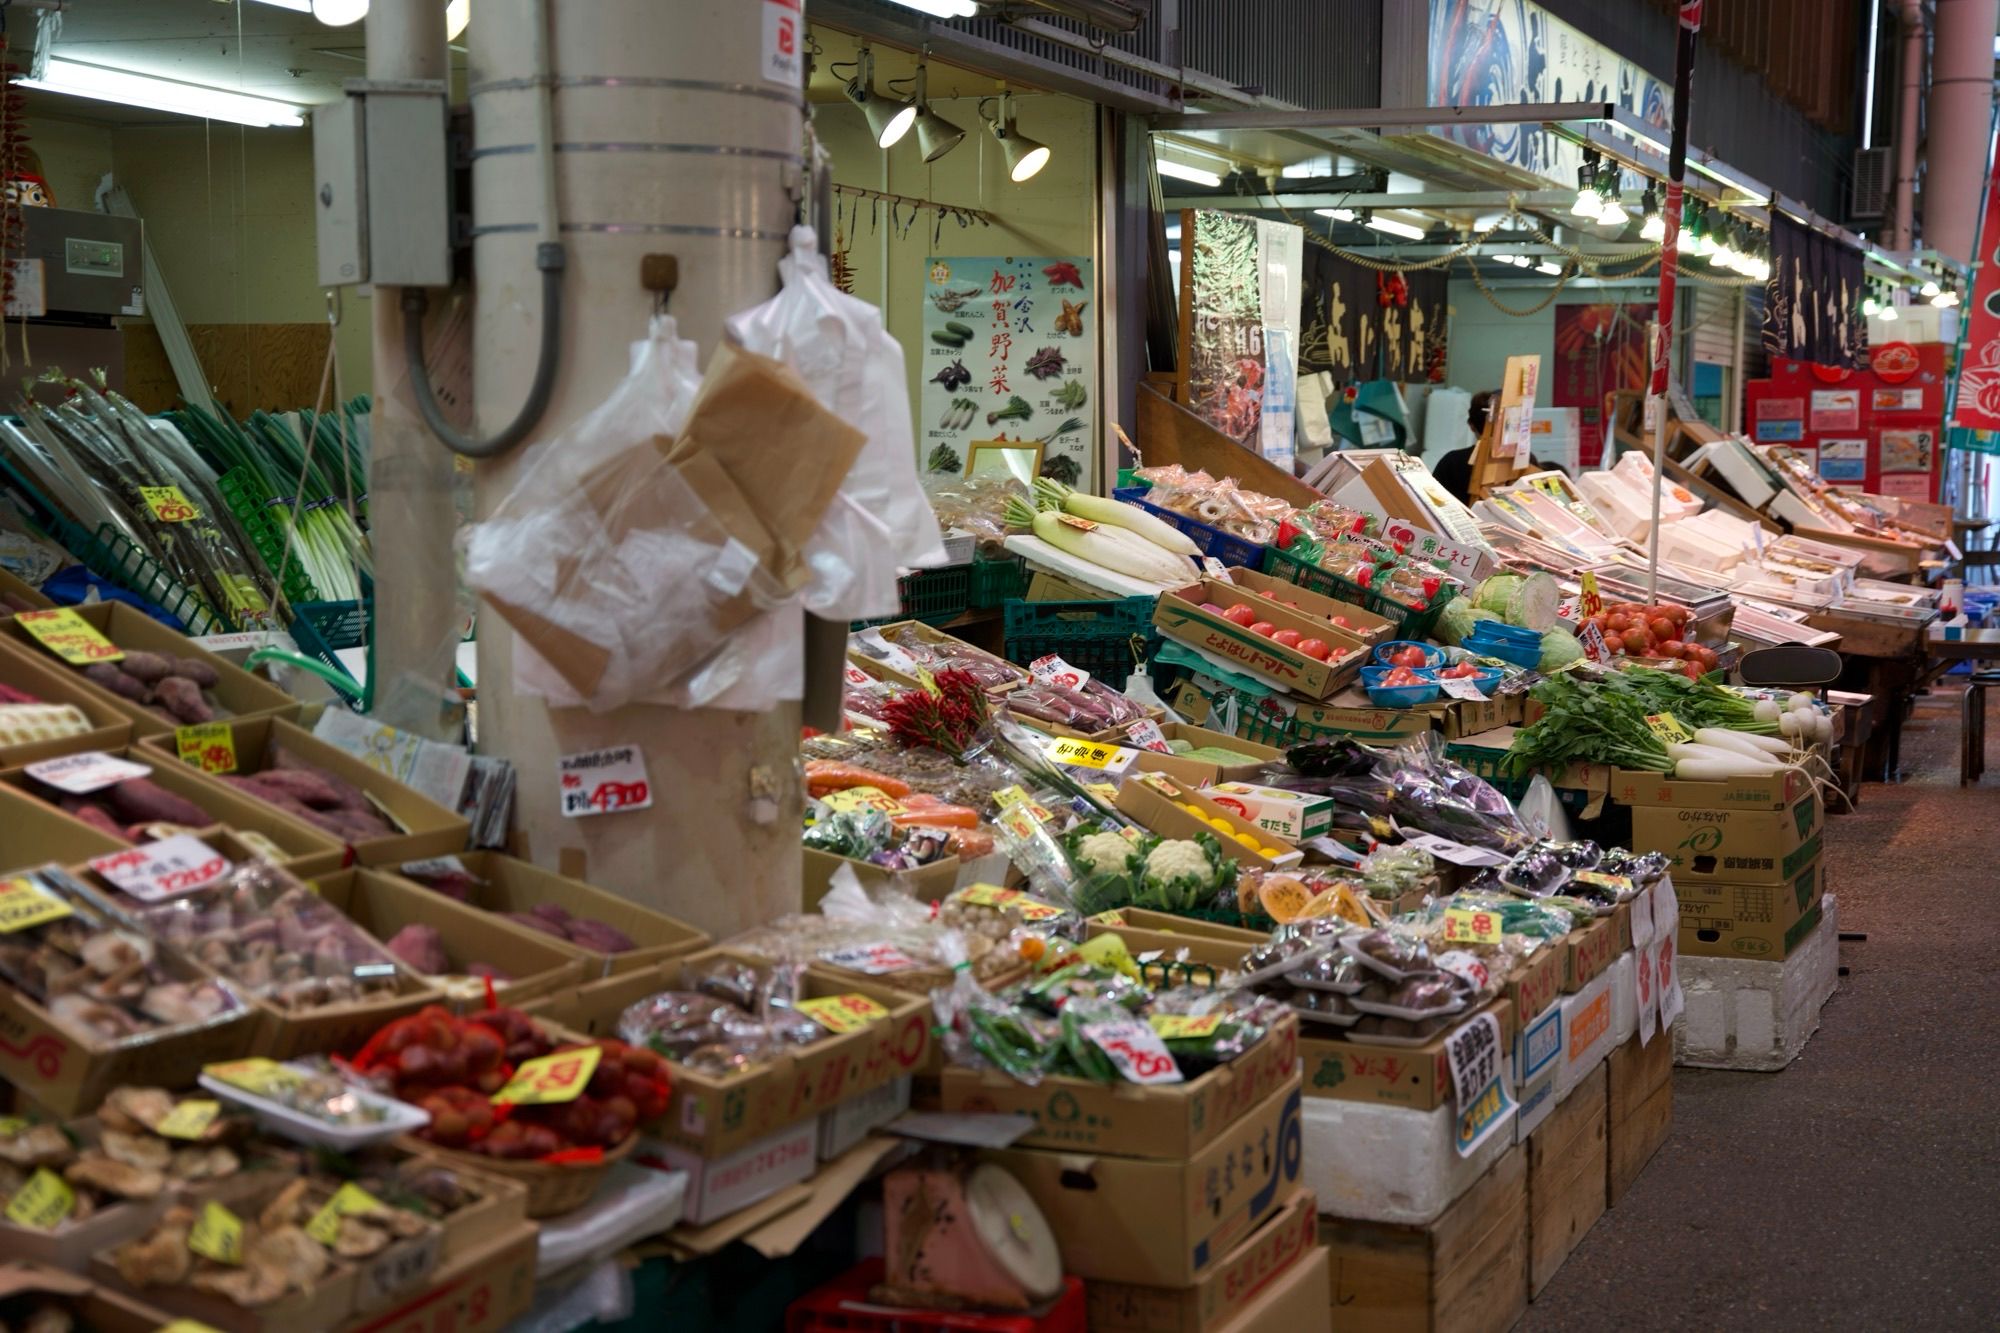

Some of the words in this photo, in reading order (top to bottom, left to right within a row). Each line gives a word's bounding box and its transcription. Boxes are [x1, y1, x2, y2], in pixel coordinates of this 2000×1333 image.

[988, 270, 1016, 395] 加賀野菜
[1206, 632, 1298, 679] とよはしトマト
[1057, 743, 1108, 761] 宅急便
[1260, 818, 1291, 832] すだち
[1678, 810, 1730, 823] JAなかの
